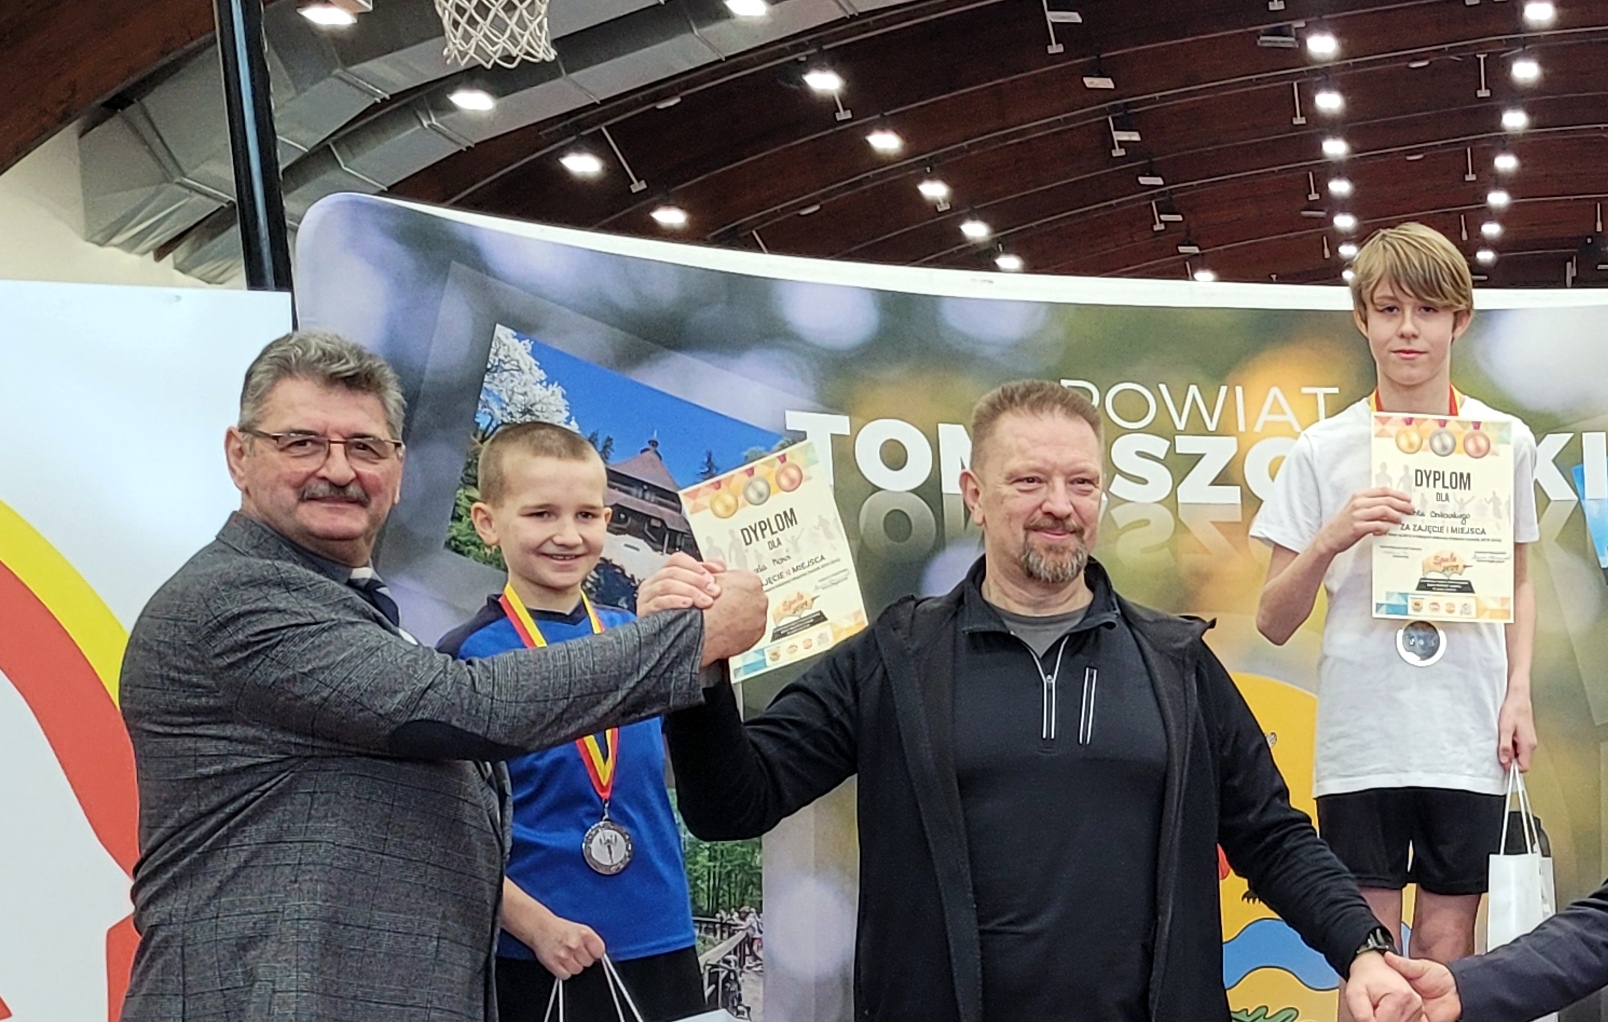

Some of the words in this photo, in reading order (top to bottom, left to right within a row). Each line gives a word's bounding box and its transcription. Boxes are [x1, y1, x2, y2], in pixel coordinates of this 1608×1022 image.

[785, 410, 1608, 504] TOSZOKI
[1414, 468, 1471, 491] DYPLOM
[1435, 492, 1450, 503] DLA
[740, 507, 798, 546] DYPLOM
[1450, 526, 1487, 536] MIEJSCA
[767, 537, 782, 551] DLA
[791, 554, 826, 574] MIEJSCA
